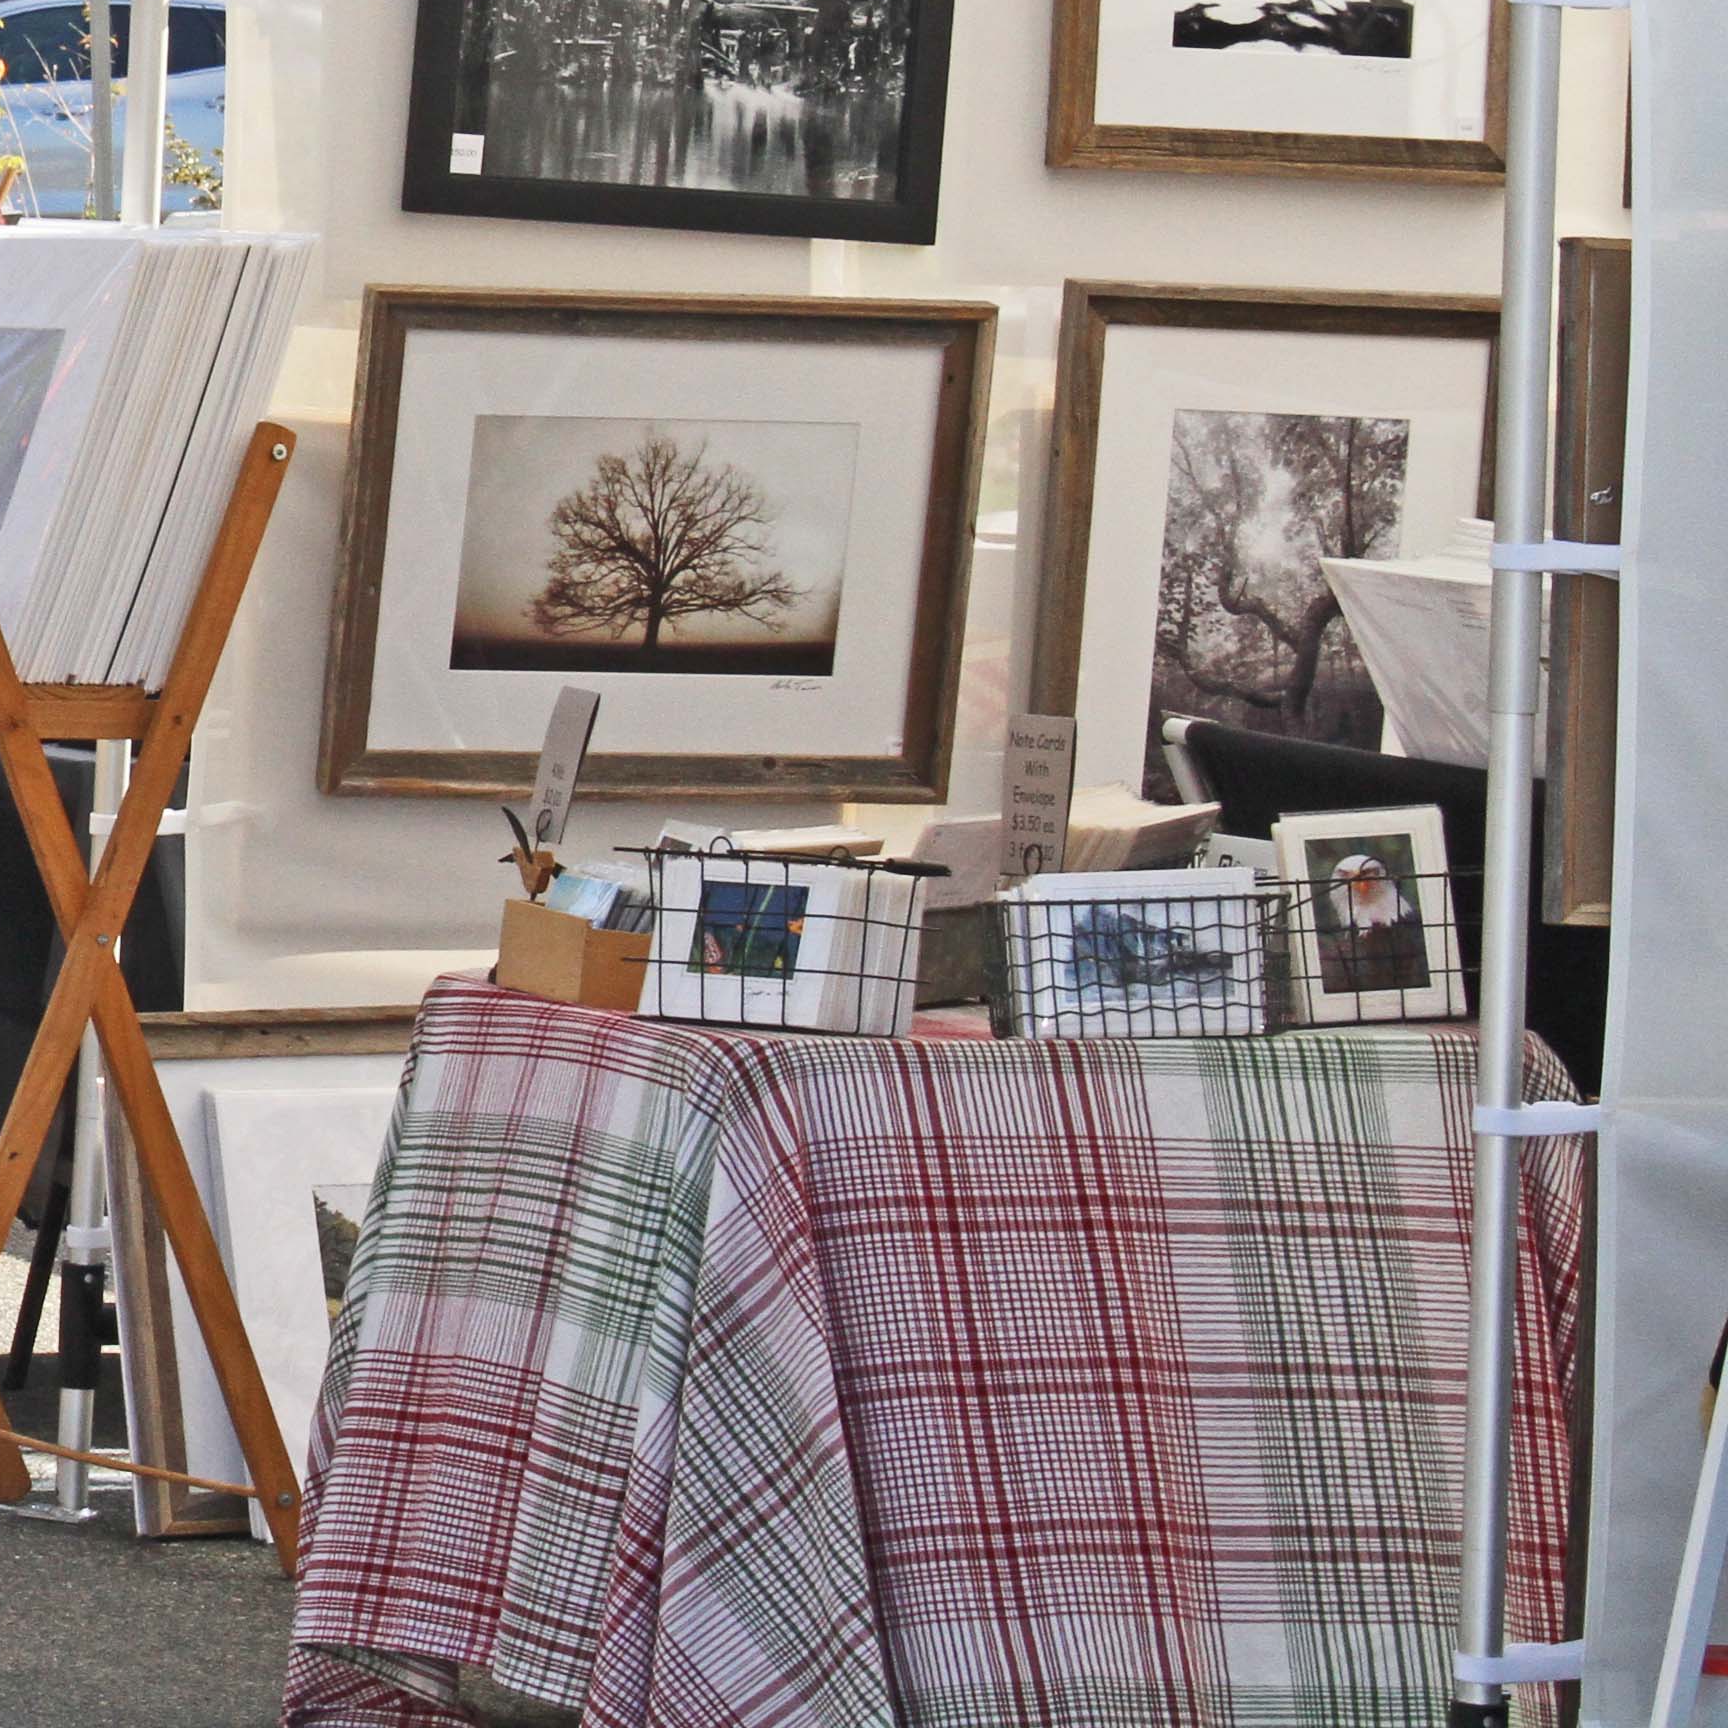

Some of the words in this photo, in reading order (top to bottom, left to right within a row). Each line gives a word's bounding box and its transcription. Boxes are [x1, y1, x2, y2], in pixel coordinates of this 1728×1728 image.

[1010, 730, 1034, 750] Note
[1037, 734, 1067, 752] Cards
[1024, 760, 1050, 777] With
[1013, 785, 1056, 809] Envelope
[1012, 813, 1041, 833] $3.50
[1009, 841, 1016, 858] 3
